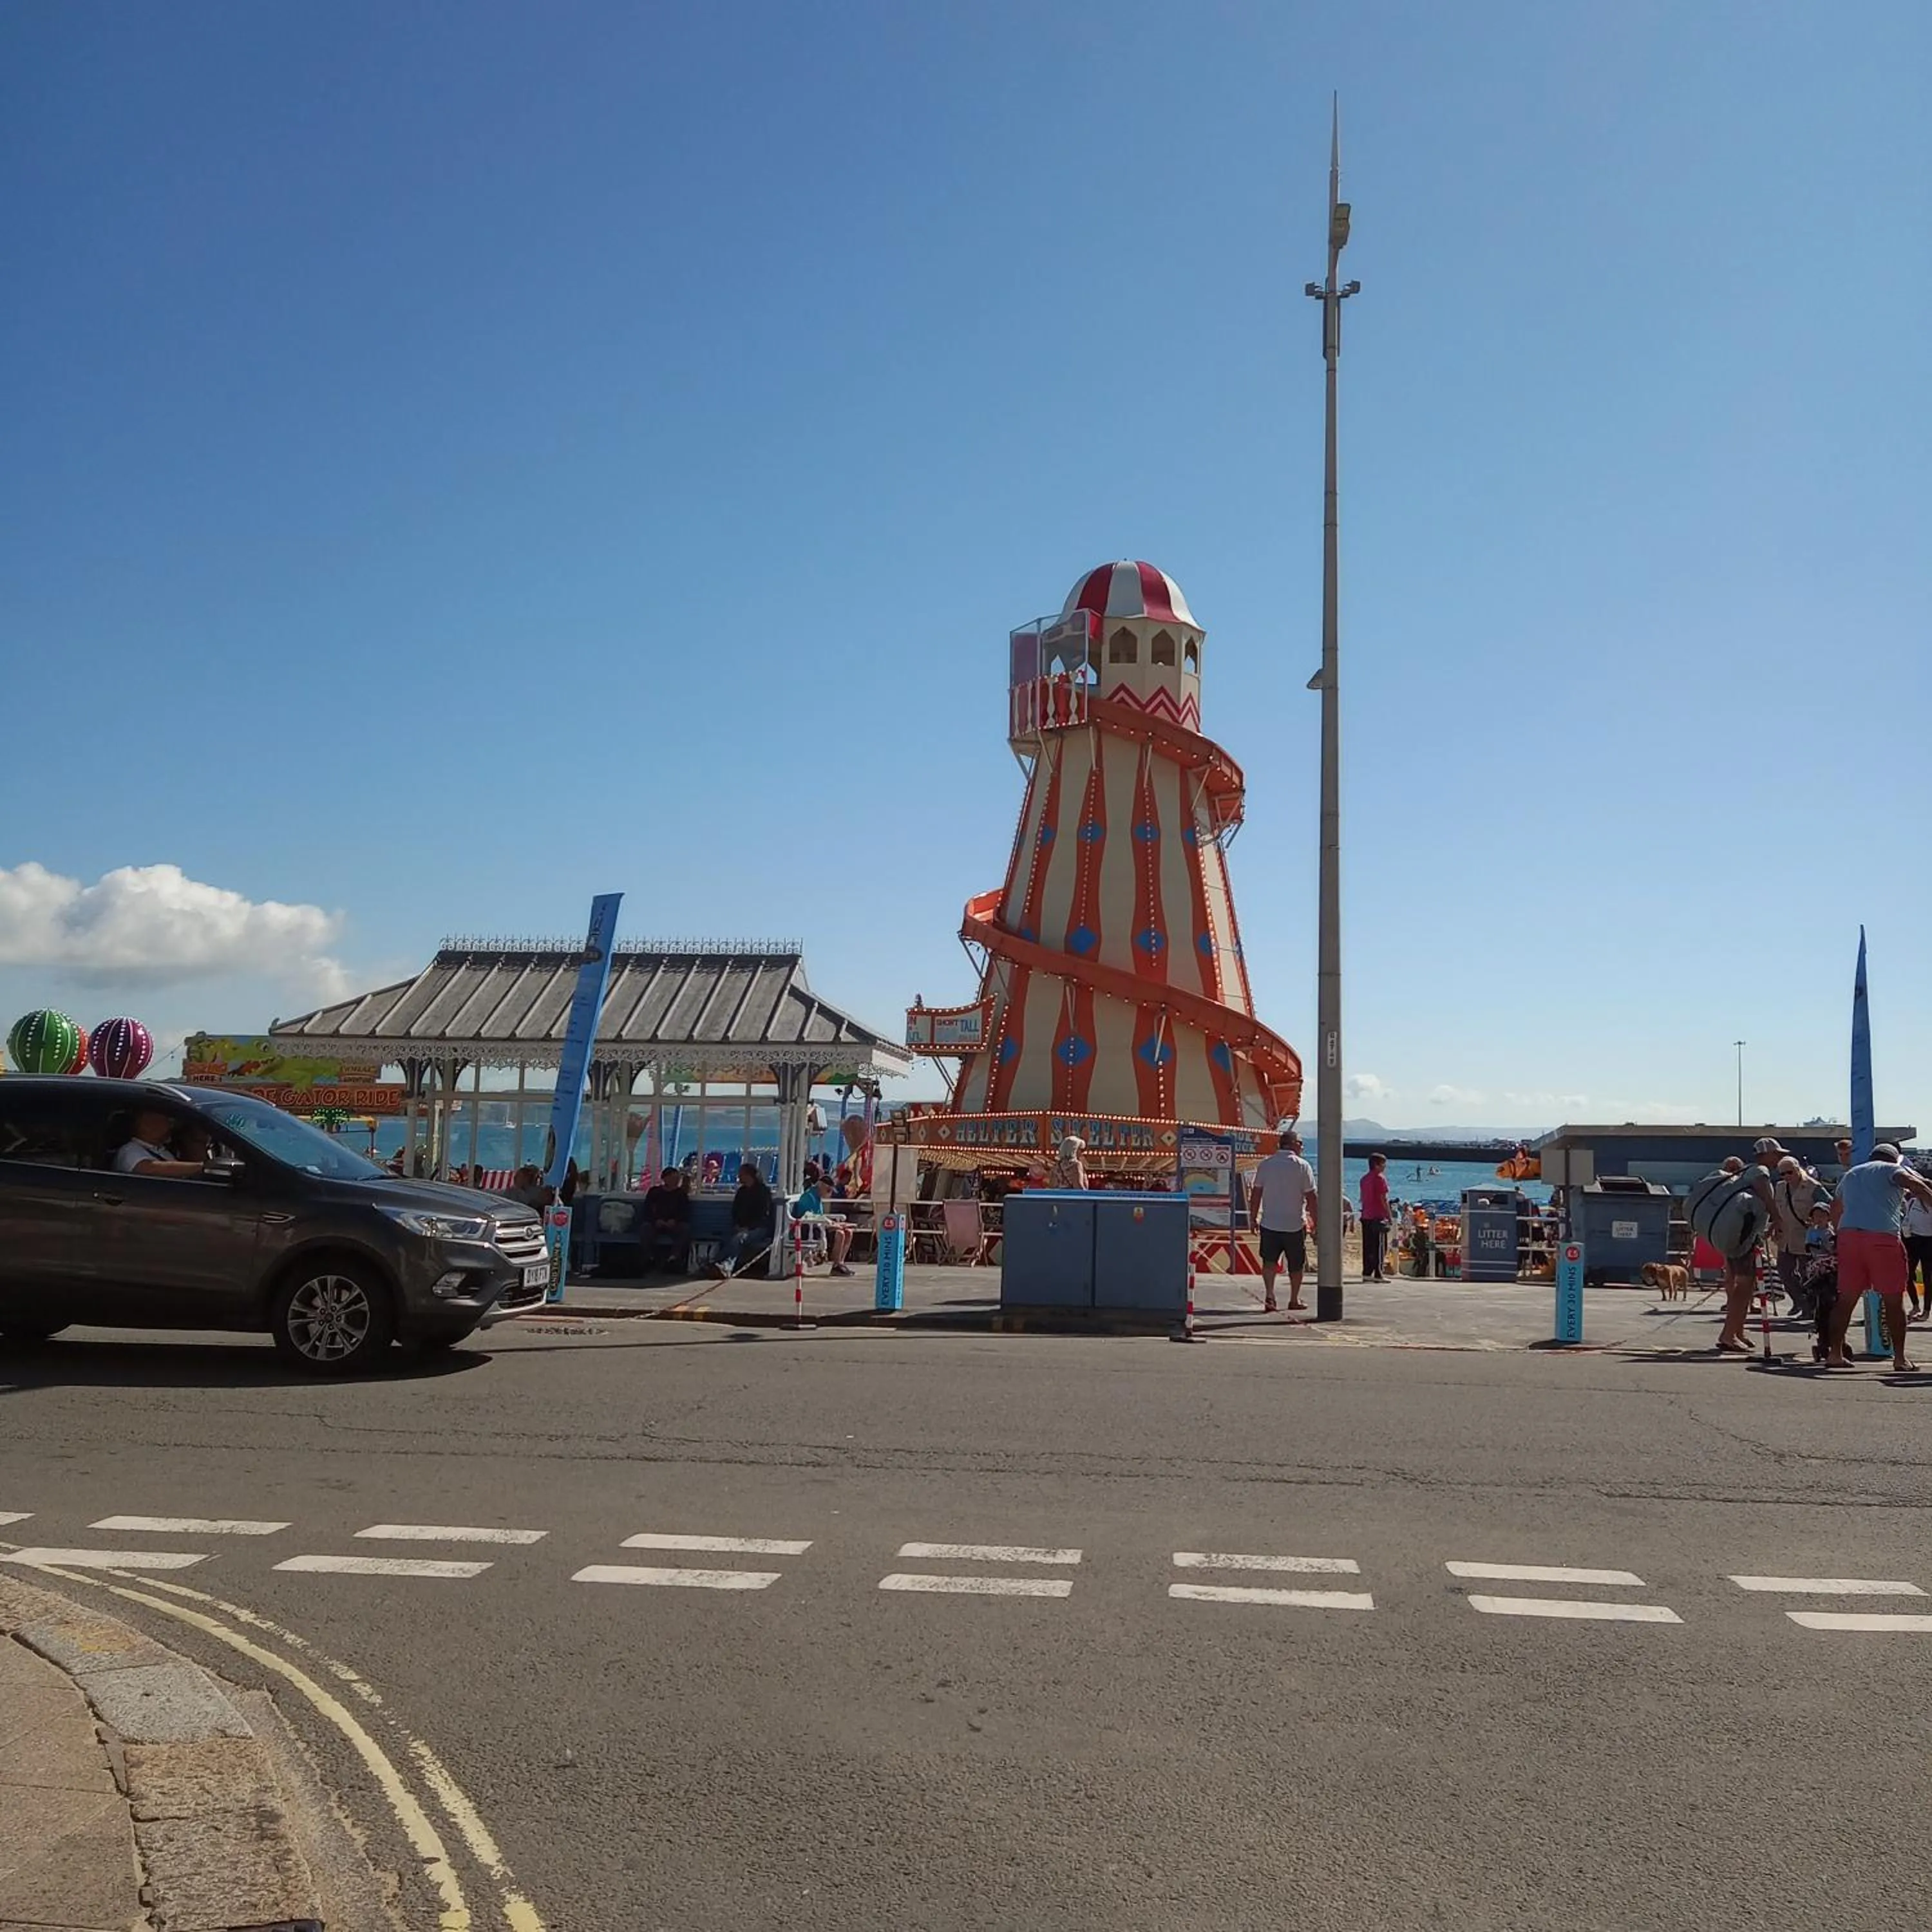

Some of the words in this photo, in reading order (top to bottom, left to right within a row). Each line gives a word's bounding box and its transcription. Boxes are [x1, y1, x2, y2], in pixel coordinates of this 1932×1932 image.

[281, 1088, 350, 1105] GATOR
[355, 1088, 399, 1106] RIDE
[956, 1117, 1038, 1146] HELTER
[1050, 1117, 1154, 1148] SKELTER
[1478, 1229, 1508, 1239] LITTER
[1481, 1240, 1506, 1249] HERE
[881, 1276, 890, 1305] EVERY
[1567, 1267, 1577, 1291] MINS
[1567, 1306, 1576, 1338] EVERY
